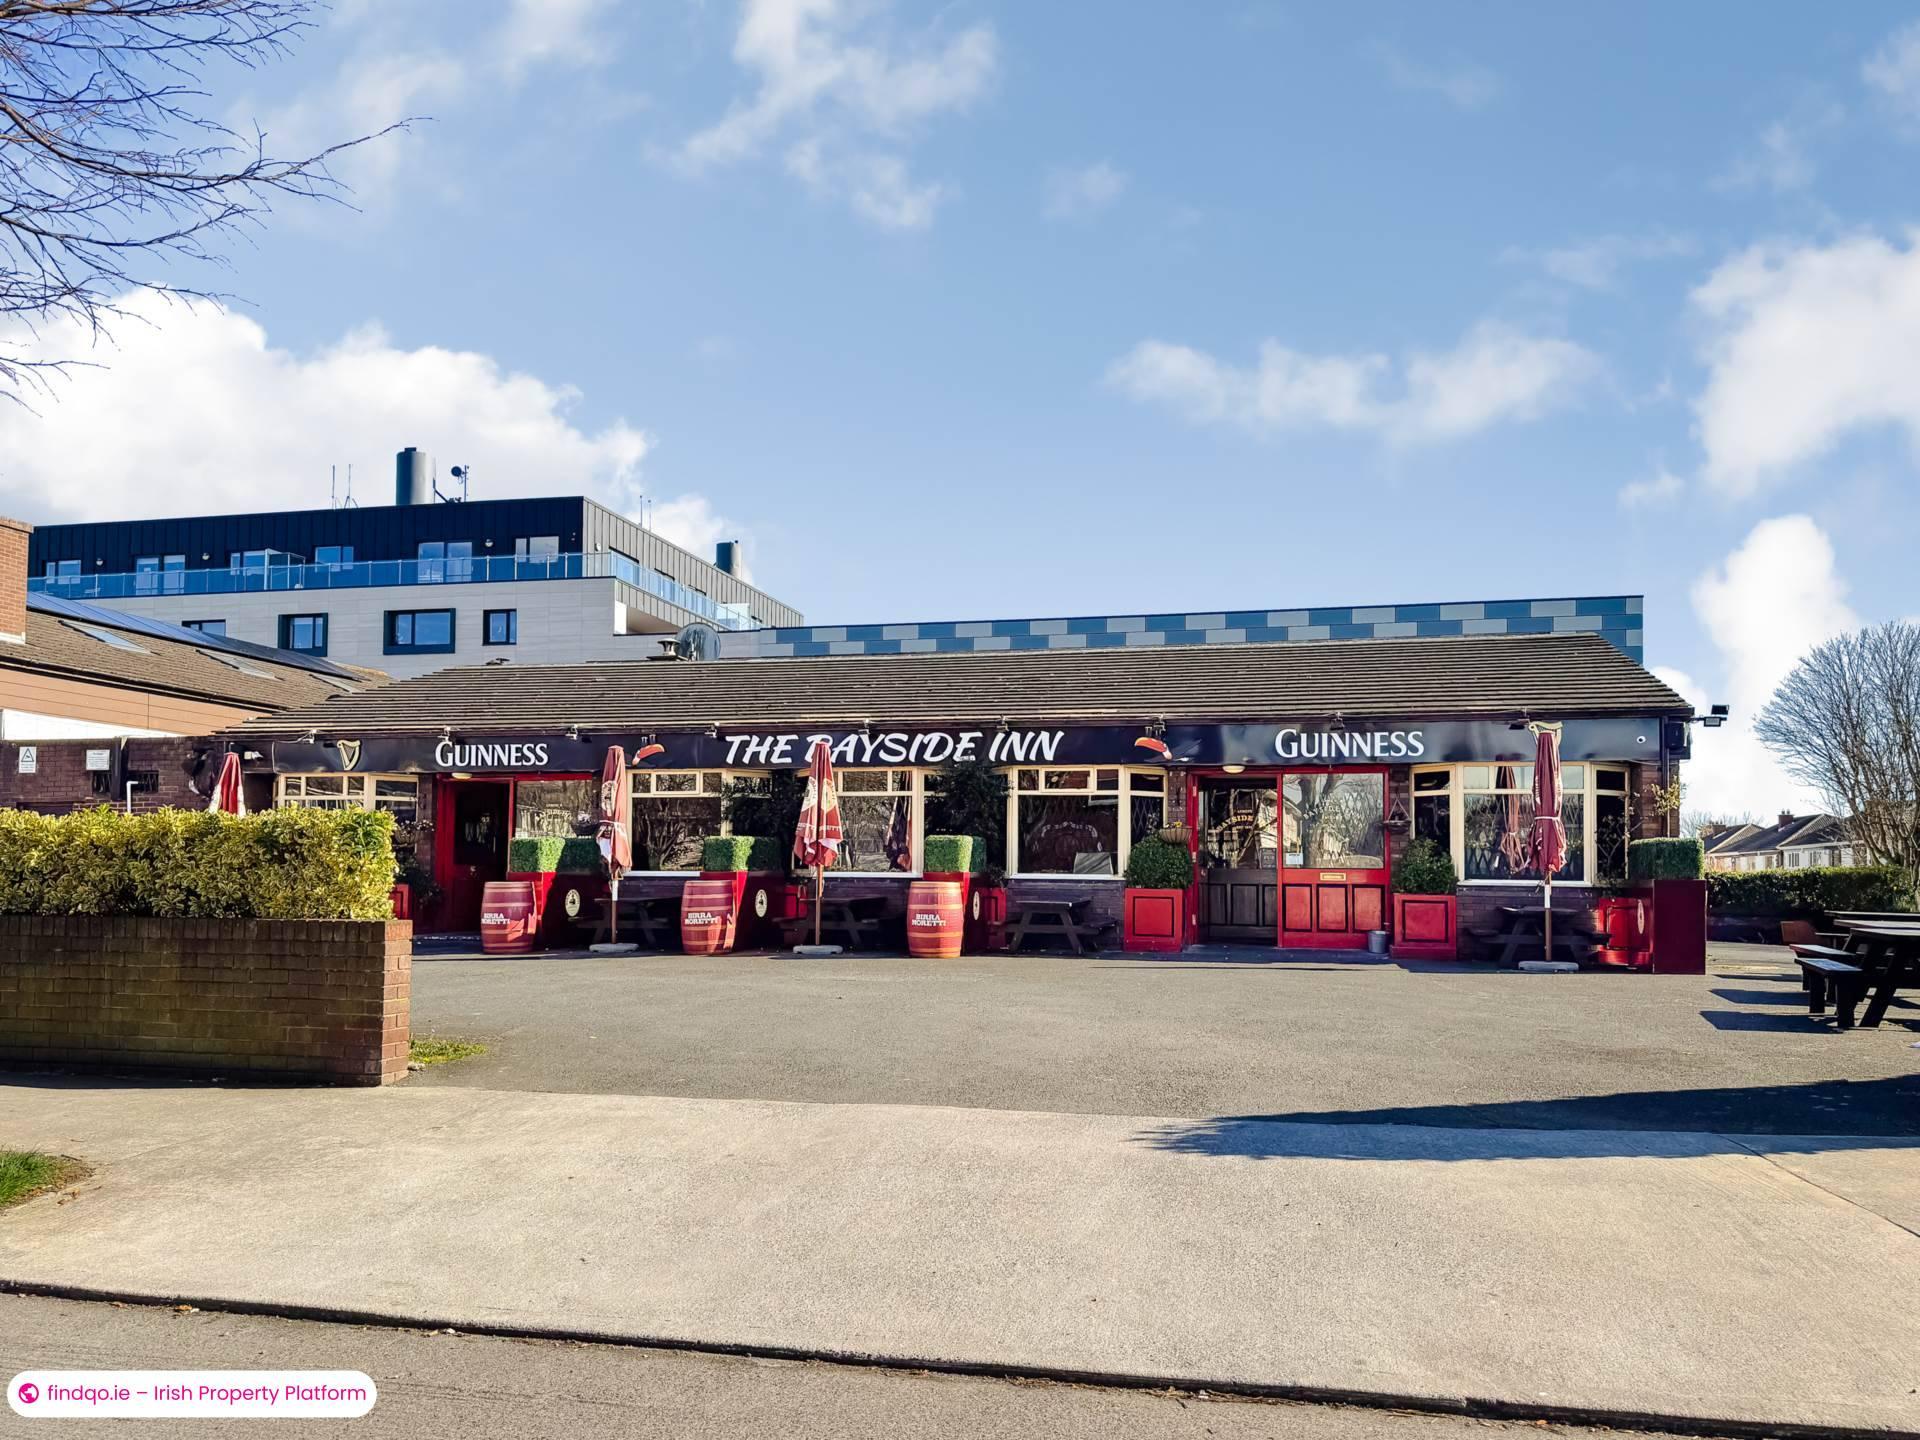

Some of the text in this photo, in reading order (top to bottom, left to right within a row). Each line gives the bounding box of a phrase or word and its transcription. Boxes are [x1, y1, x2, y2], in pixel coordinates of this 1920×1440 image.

[435, 741, 548, 767] GUINNESS
[725, 734, 799, 764] THE
[988, 730, 1065, 762] INN
[1274, 728, 1425, 758] GUINNESS
[911, 919, 947, 927] MORETTI
